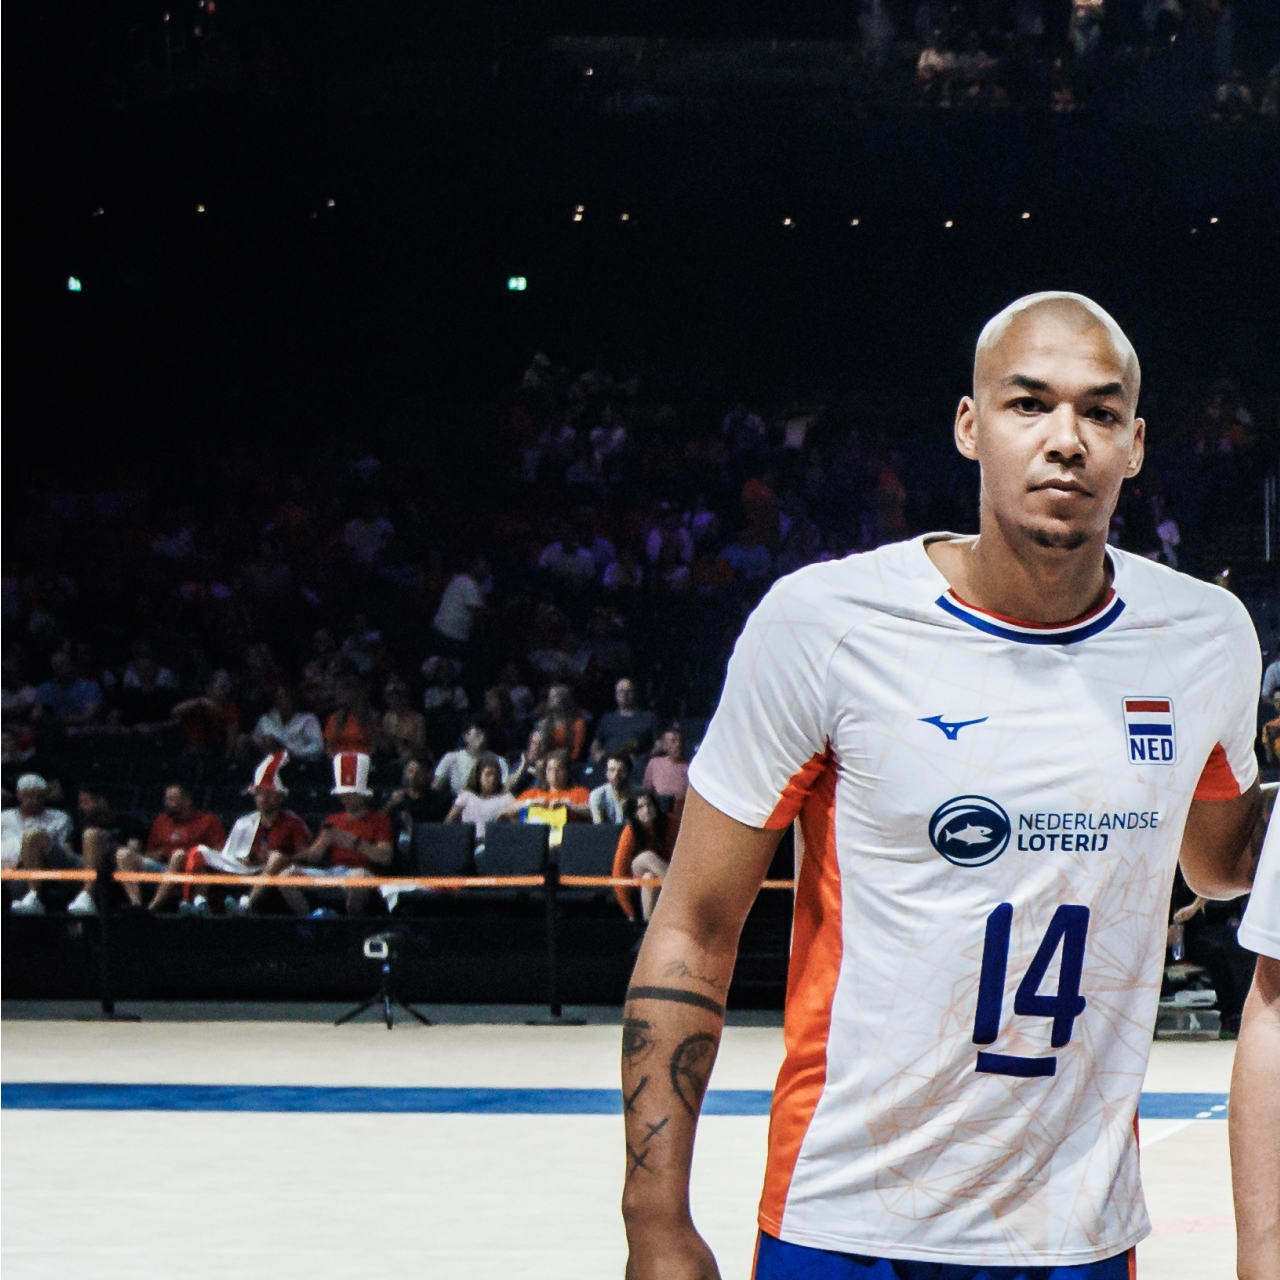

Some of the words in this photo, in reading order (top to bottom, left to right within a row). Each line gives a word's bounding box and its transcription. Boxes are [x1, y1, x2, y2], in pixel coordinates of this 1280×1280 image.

[1130, 738, 1174, 761] NED
[1018, 811, 1160, 831] NEDERLANDSE
[1017, 834, 1109, 851] LOTERIJ
[972, 902, 1091, 1048] 14
